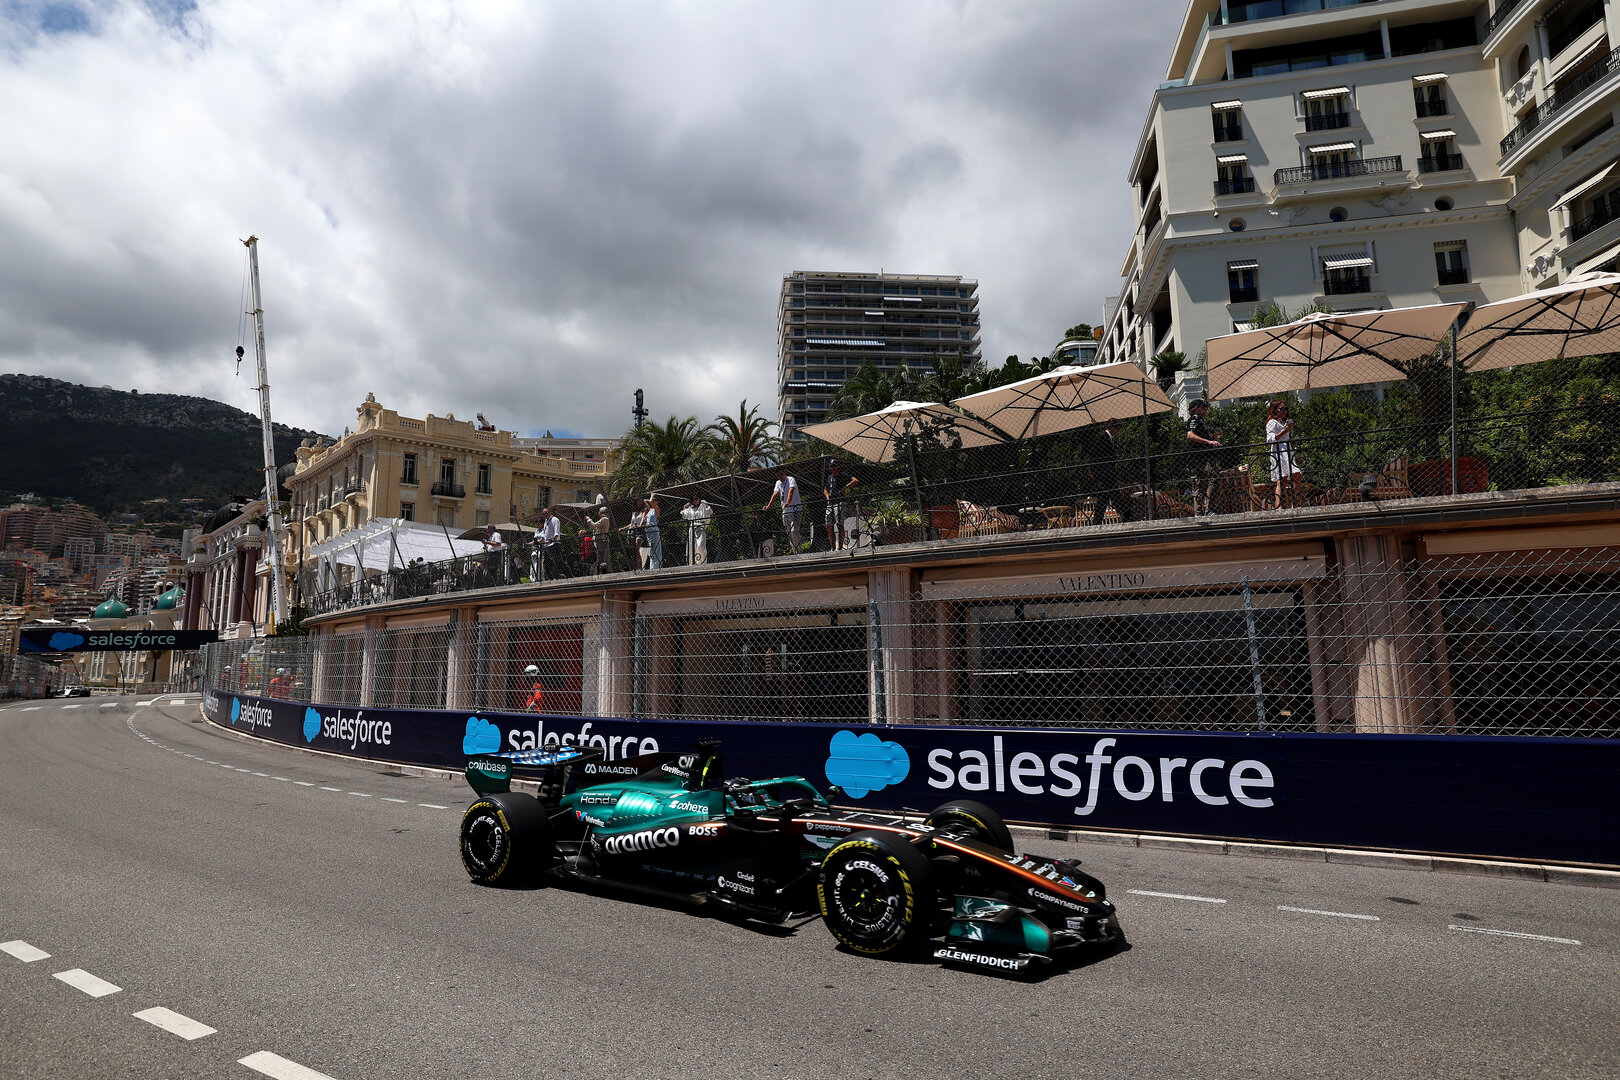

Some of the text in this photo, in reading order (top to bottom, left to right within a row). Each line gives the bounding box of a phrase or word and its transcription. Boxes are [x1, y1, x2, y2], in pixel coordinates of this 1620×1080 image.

[1059, 573, 1145, 591] VALENTINO
[88, 632, 176, 649] salesforce
[240, 699, 272, 731] salesforce
[323, 709, 392, 750] salesforce
[468, 760, 507, 773] coinbase
[598, 765, 639, 775] MAADEN
[661, 763, 690, 778] CoreWeave
[927, 735, 1275, 816] salesforce
[580, 796, 618, 805] Honda
[677, 800, 709, 815] cohere
[688, 825, 718, 837] BOSS
[814, 823, 852, 833] pepperstone
[605, 827, 680, 855] aramco
[852, 860, 889, 883] CELSIUS
[725, 880, 755, 896] cognizant
[1034, 890, 1090, 914] COINPAYMENTS
[865, 905, 895, 933] CELSIUS
[938, 949, 1020, 970] GLENFIDDICH
